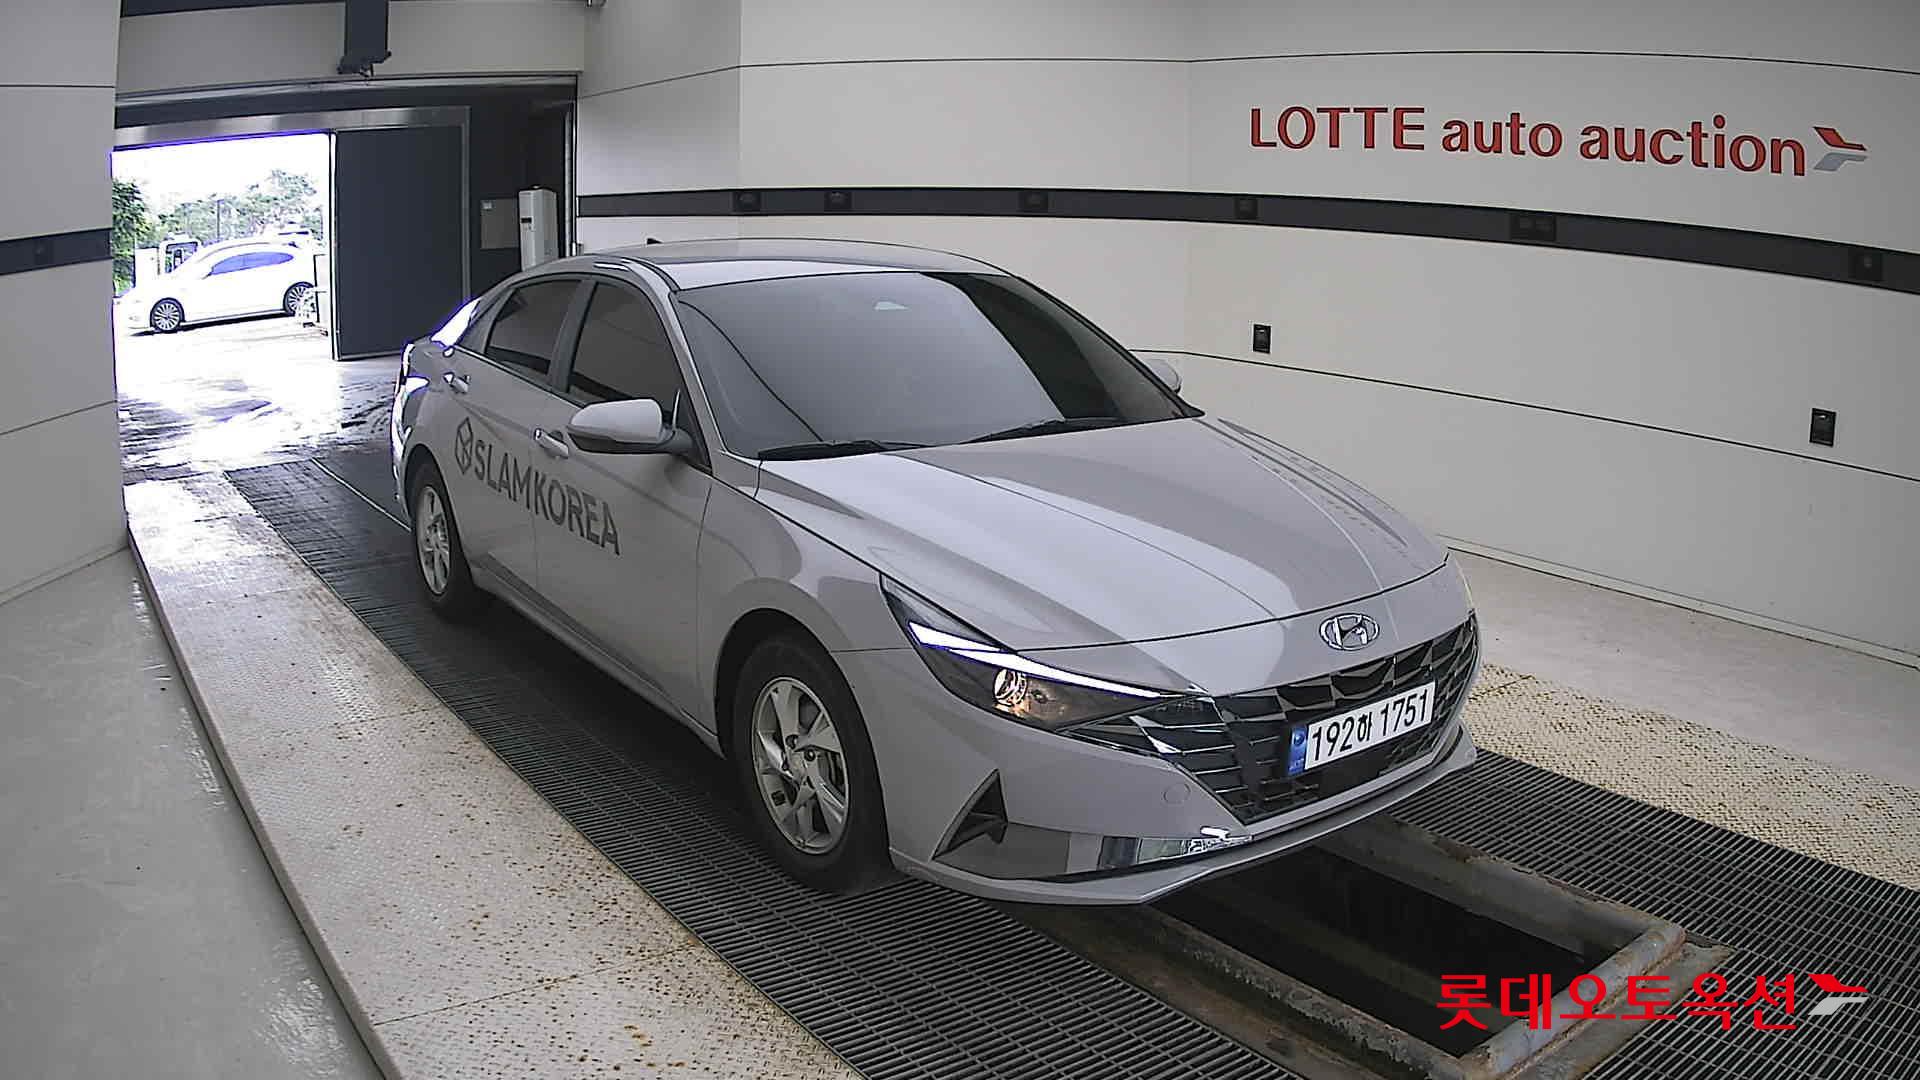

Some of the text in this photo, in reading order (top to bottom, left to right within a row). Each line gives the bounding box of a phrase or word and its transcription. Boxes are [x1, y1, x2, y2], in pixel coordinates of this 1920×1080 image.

[1251, 106, 1806, 176] LOTTE auto auction
[475, 438, 621, 556] SLAMKOREA
[1381, 689, 1428, 737] 1751
